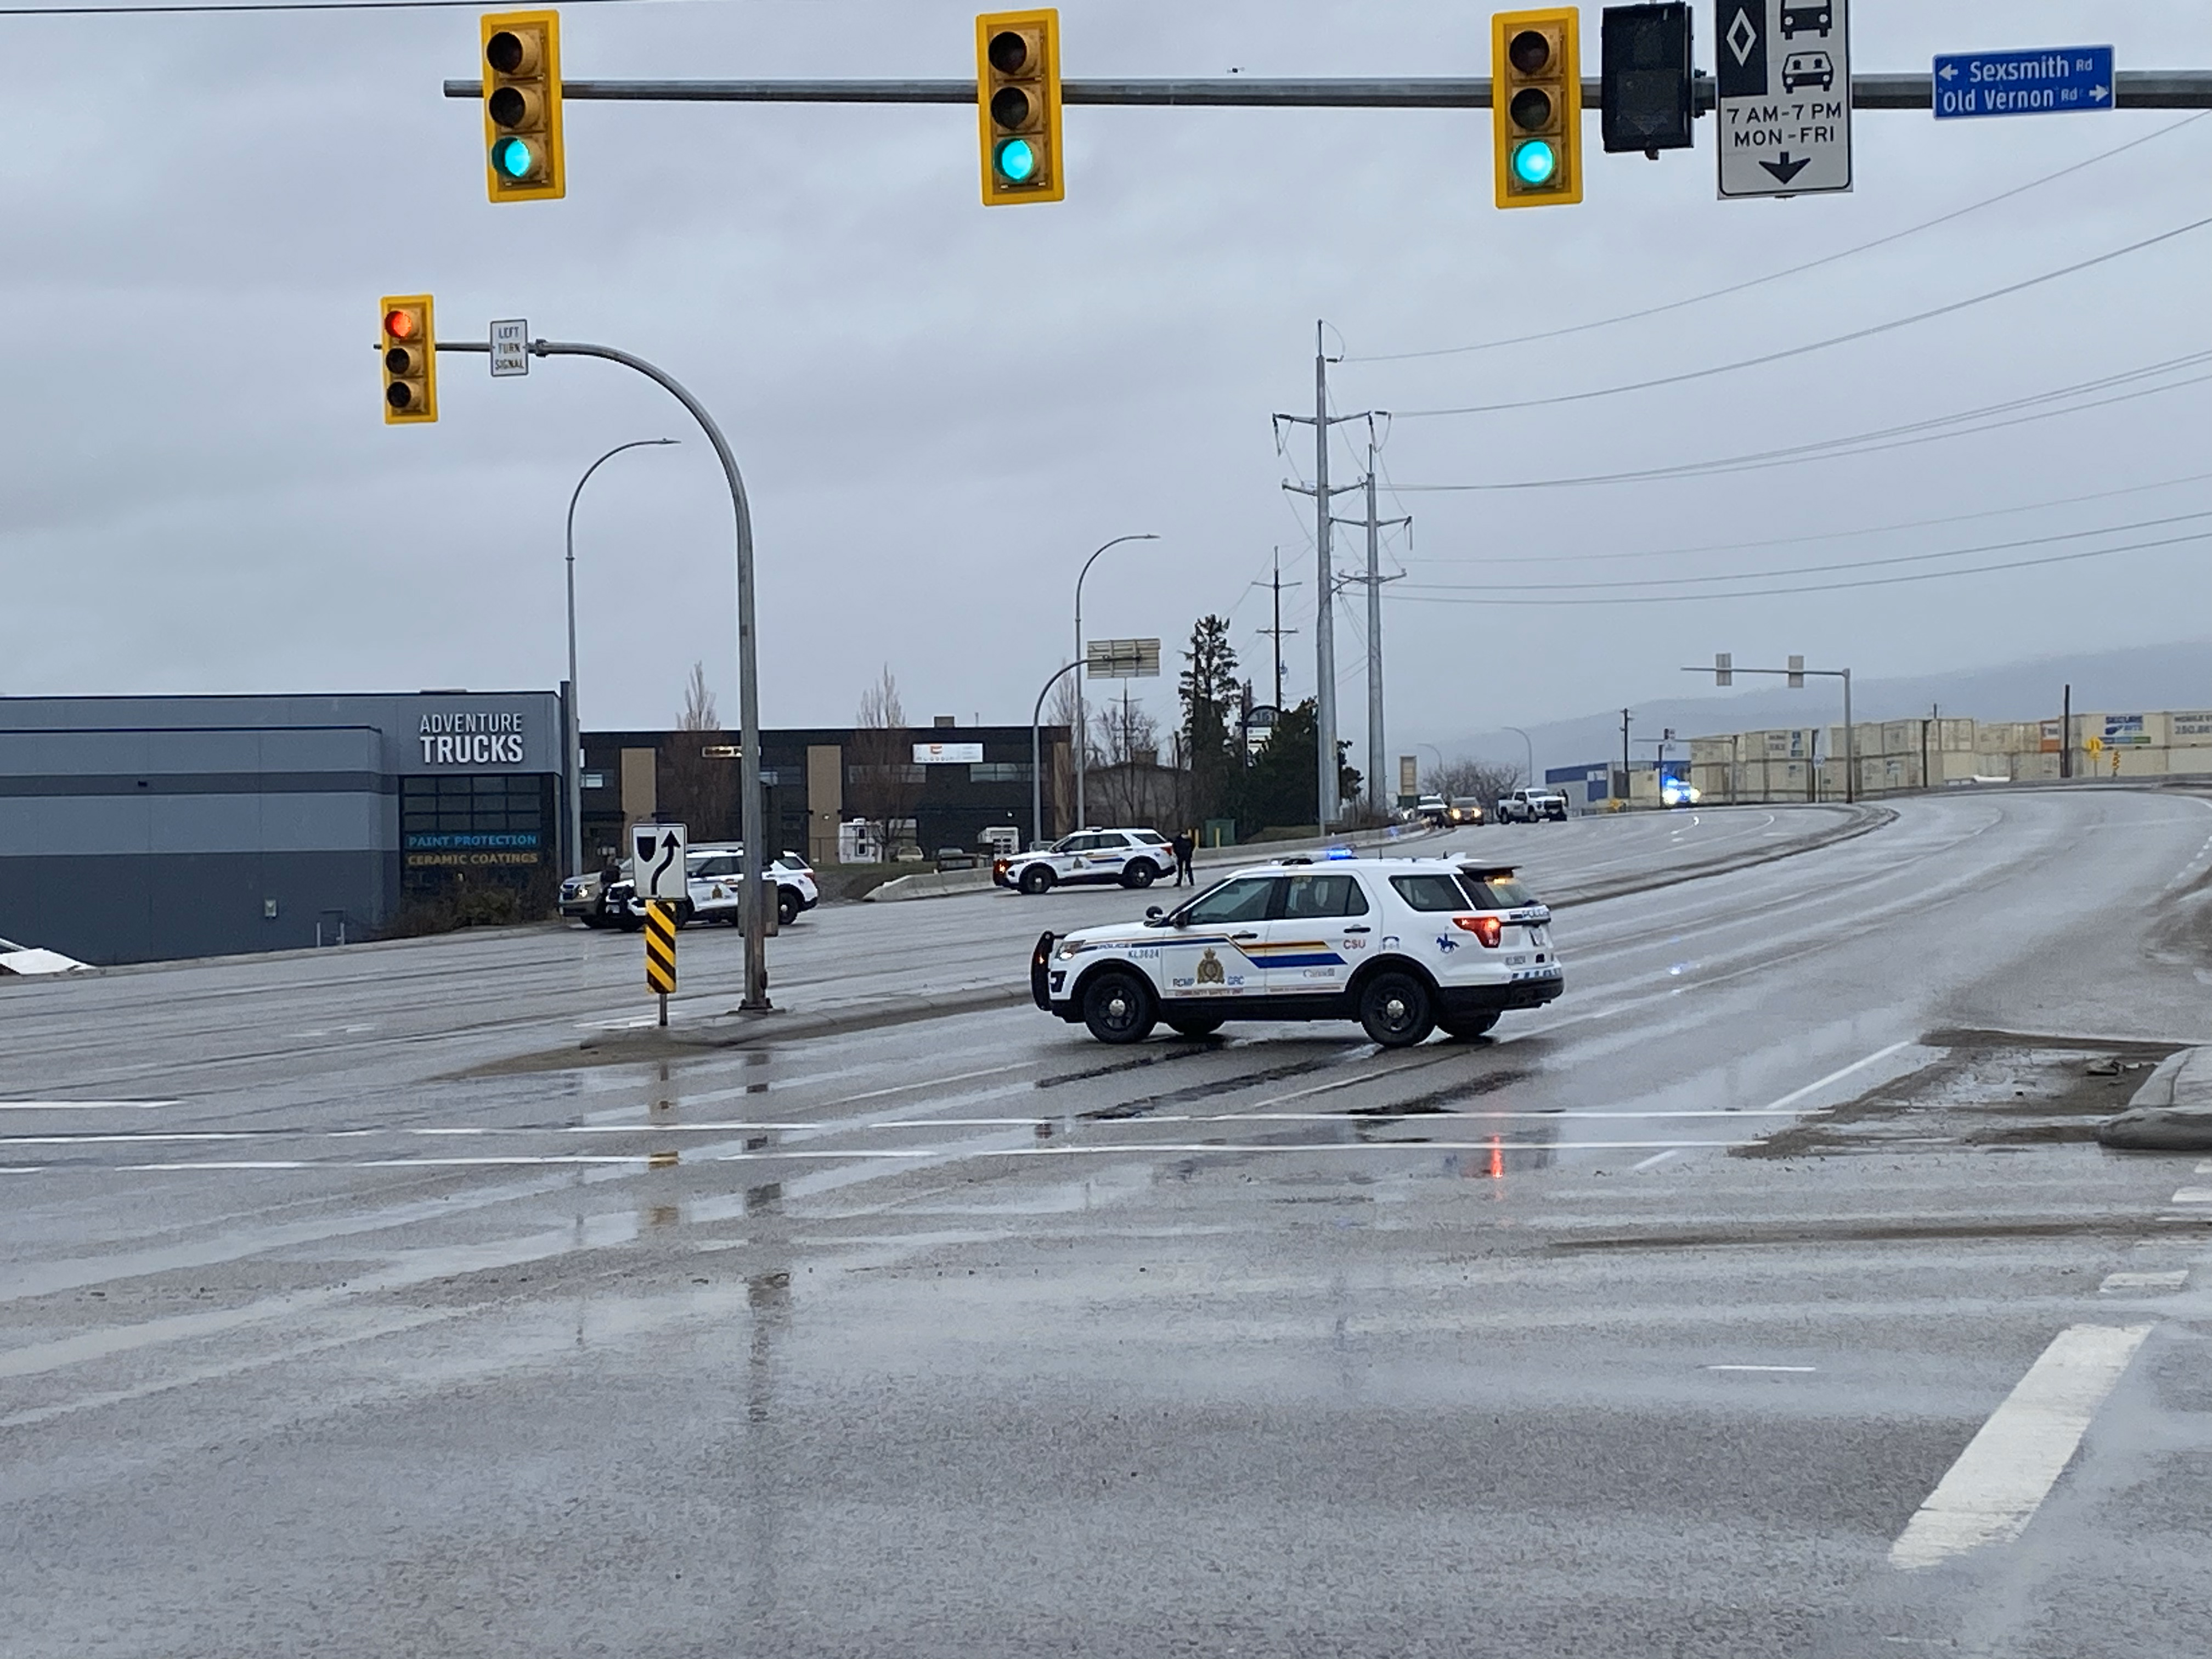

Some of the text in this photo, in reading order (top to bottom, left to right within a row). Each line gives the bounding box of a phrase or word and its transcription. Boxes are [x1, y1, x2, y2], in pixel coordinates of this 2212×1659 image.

[1970, 55, 2093, 82] Sexsmith Rd
[1943, 88, 2078, 112] Old Vernon Rd
[1726, 108, 1740, 124] 7
[1812, 102, 1842, 119] PM
[420, 713, 522, 733] ADVENTURE
[420, 735, 523, 763] TRUCKS
[409, 835, 537, 847] PAINT PROTECTION
[408, 853, 538, 865] CERAMIC COATINGS
[1343, 939, 1366, 950] CSU
[1173, 978, 1195, 987] RCMP
[1227, 975, 1245, 985] GRC
